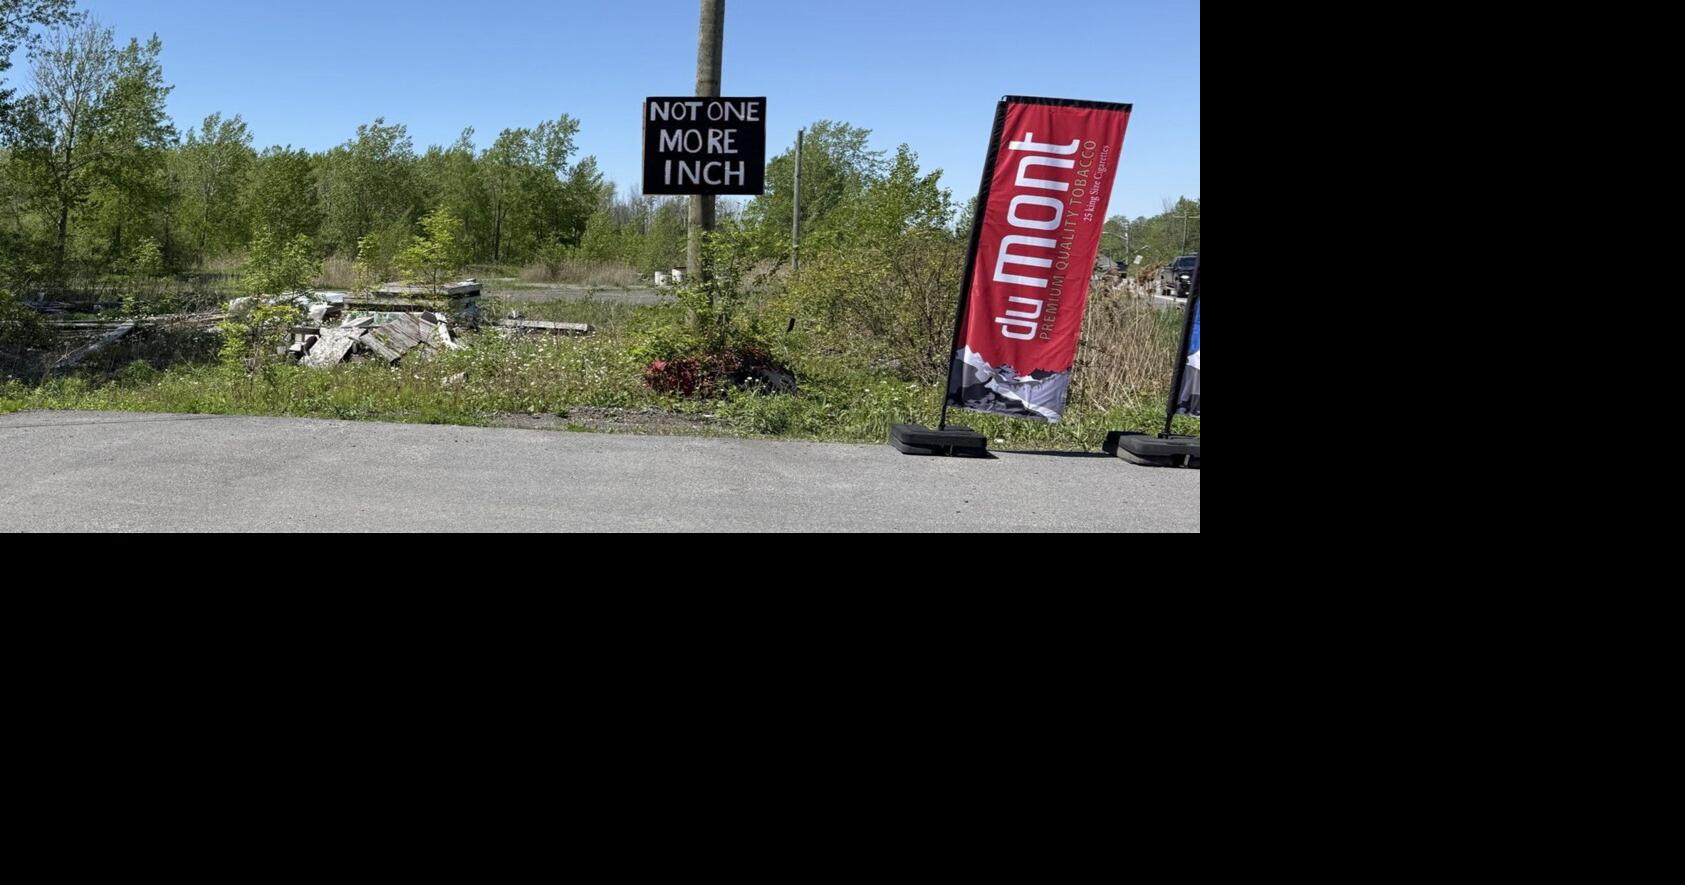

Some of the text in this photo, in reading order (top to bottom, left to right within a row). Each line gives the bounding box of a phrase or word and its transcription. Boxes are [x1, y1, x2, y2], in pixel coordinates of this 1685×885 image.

[650, 101, 760, 122] NOT ONE
[659, 129, 738, 154] MORE
[664, 160, 744, 186] INCH
[1094, 145, 1110, 180] Cigarettes
[1090, 181, 1101, 195] Size
[1083, 212, 1093, 222] 25
[1040, 140, 1096, 340] PREMIUM QUALITY TOBACCO
